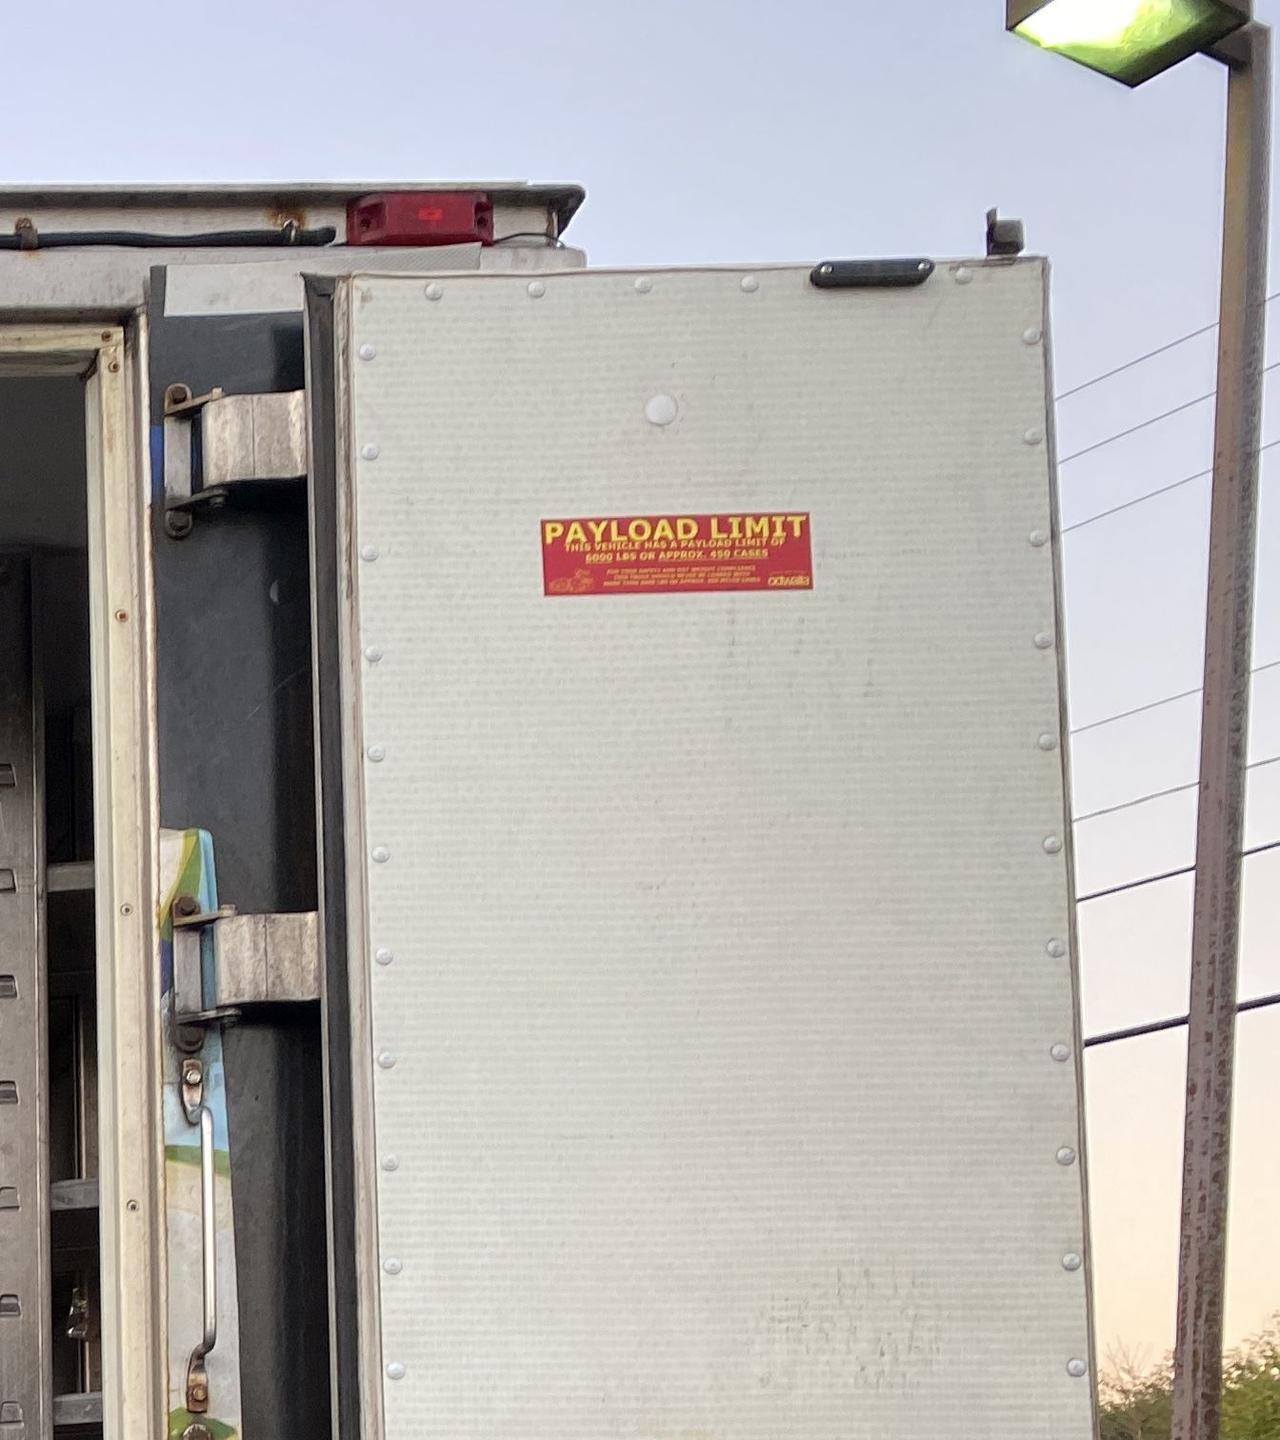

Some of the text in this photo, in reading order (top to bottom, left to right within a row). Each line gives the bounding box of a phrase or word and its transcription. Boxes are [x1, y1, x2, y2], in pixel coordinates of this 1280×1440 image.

[544, 515, 807, 545] PAYLOAD LIMIT
[594, 541, 641, 552] VEHICLE
[680, 539, 732, 549] PAYLOAD
[734, 537, 768, 548] LIMIT
